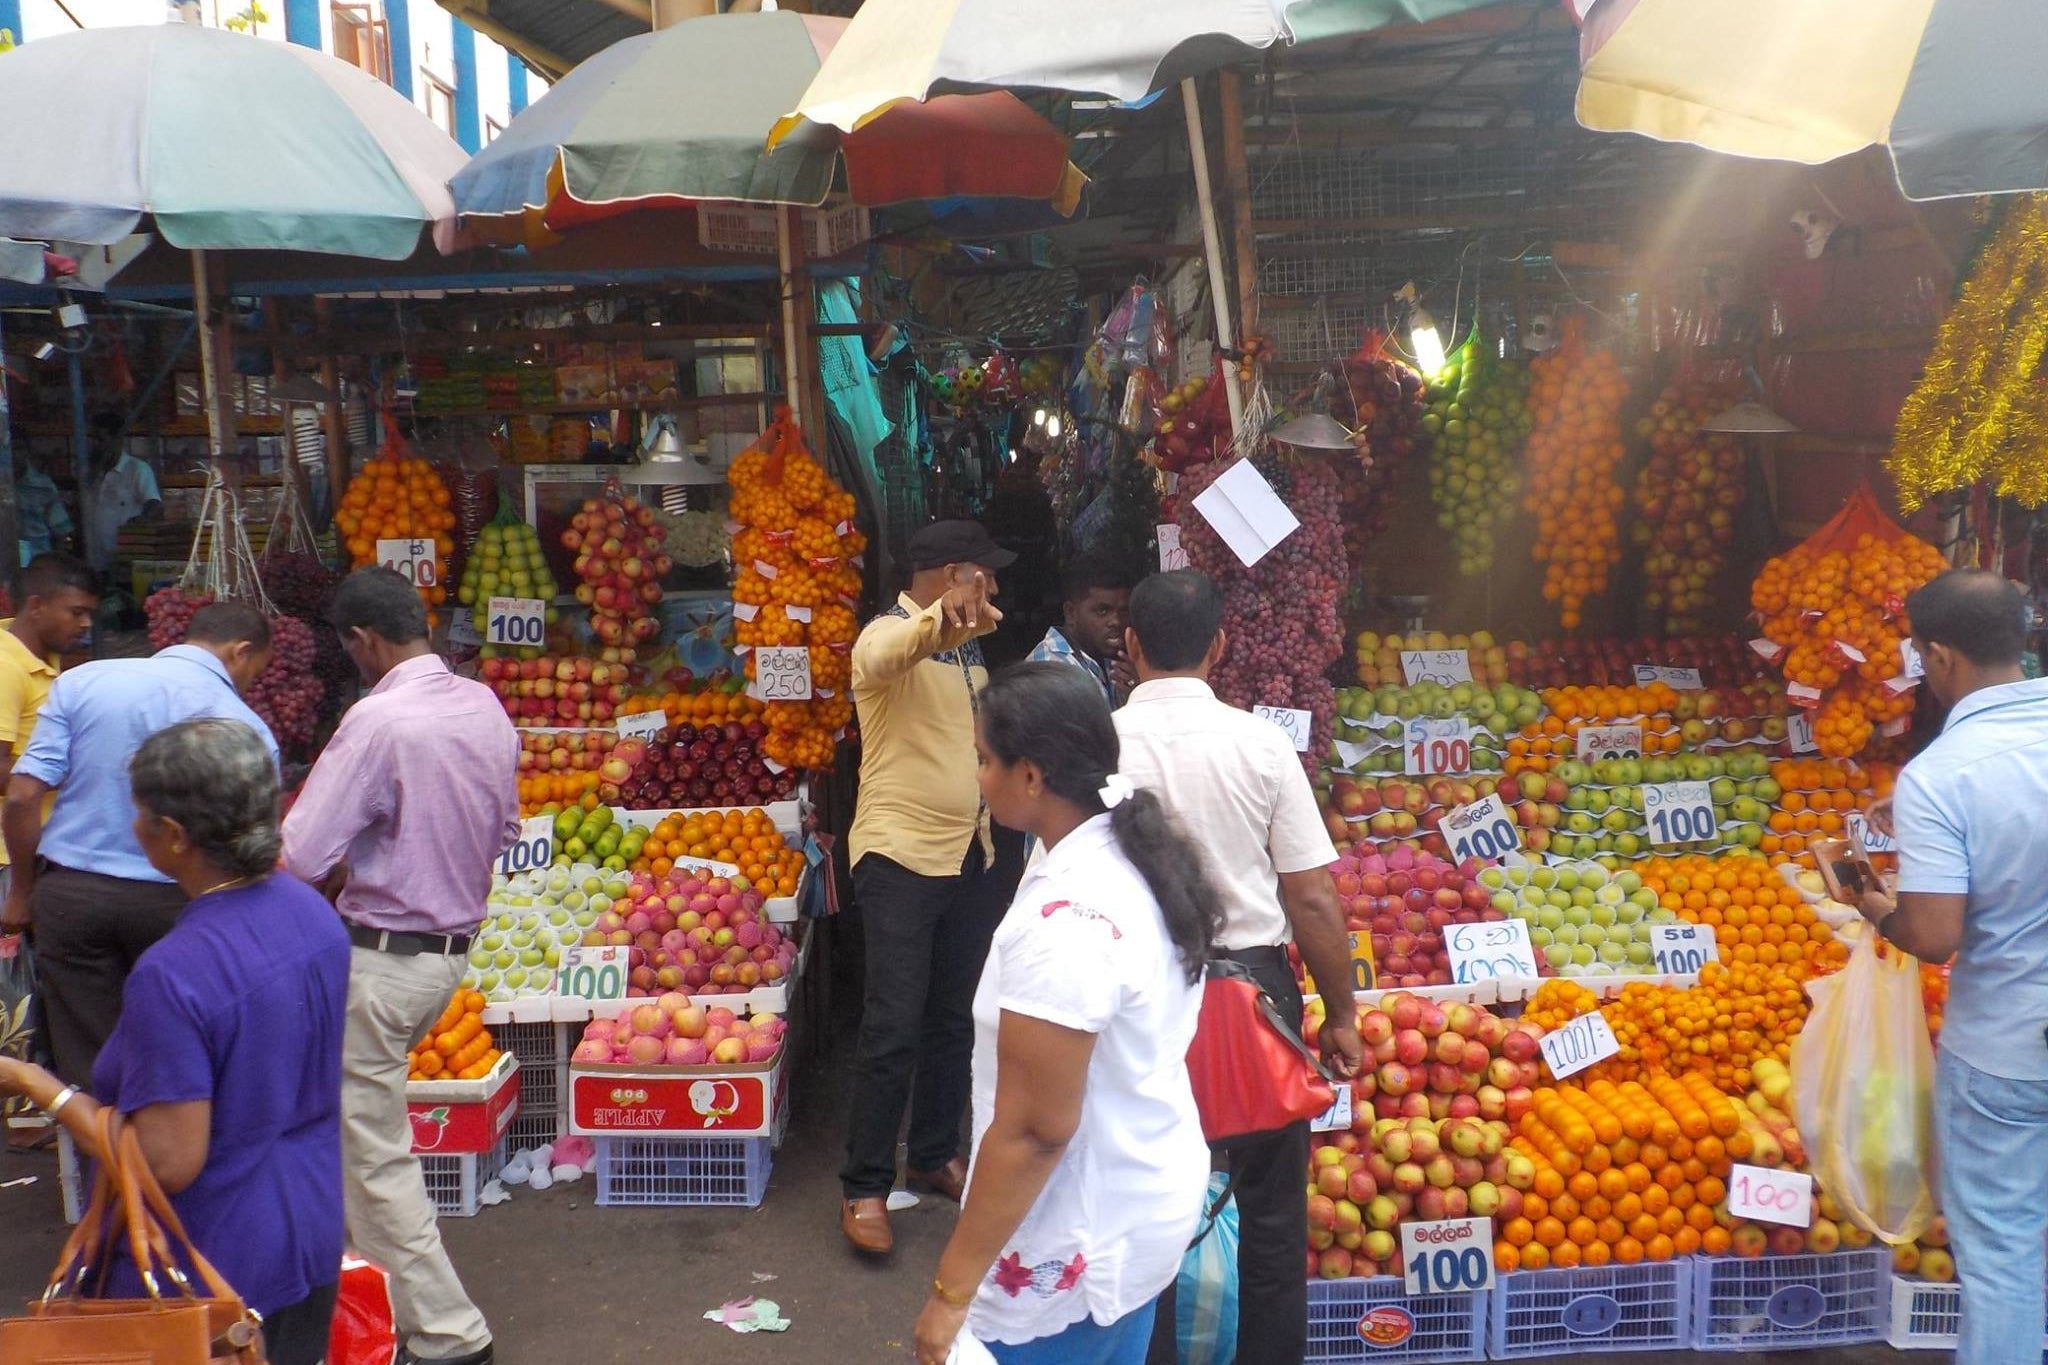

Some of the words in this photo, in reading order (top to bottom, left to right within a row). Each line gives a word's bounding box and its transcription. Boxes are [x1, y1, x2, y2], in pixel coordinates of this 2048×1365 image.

[491, 614, 543, 643] 100
[764, 672, 806, 697] 250
[1409, 720, 1429, 744] 5
[1411, 739, 1469, 773] 100
[1652, 805, 1715, 842] 100
[1455, 818, 1518, 860] 100
[496, 837, 550, 875] 100
[1454, 925, 1475, 952] 6
[1664, 928, 1679, 941] 5
[566, 947, 583, 967] 5
[593, 1107, 666, 1127] APPLE
[1736, 1175, 1799, 1210] 100
[1409, 1247, 1488, 1294] 100
